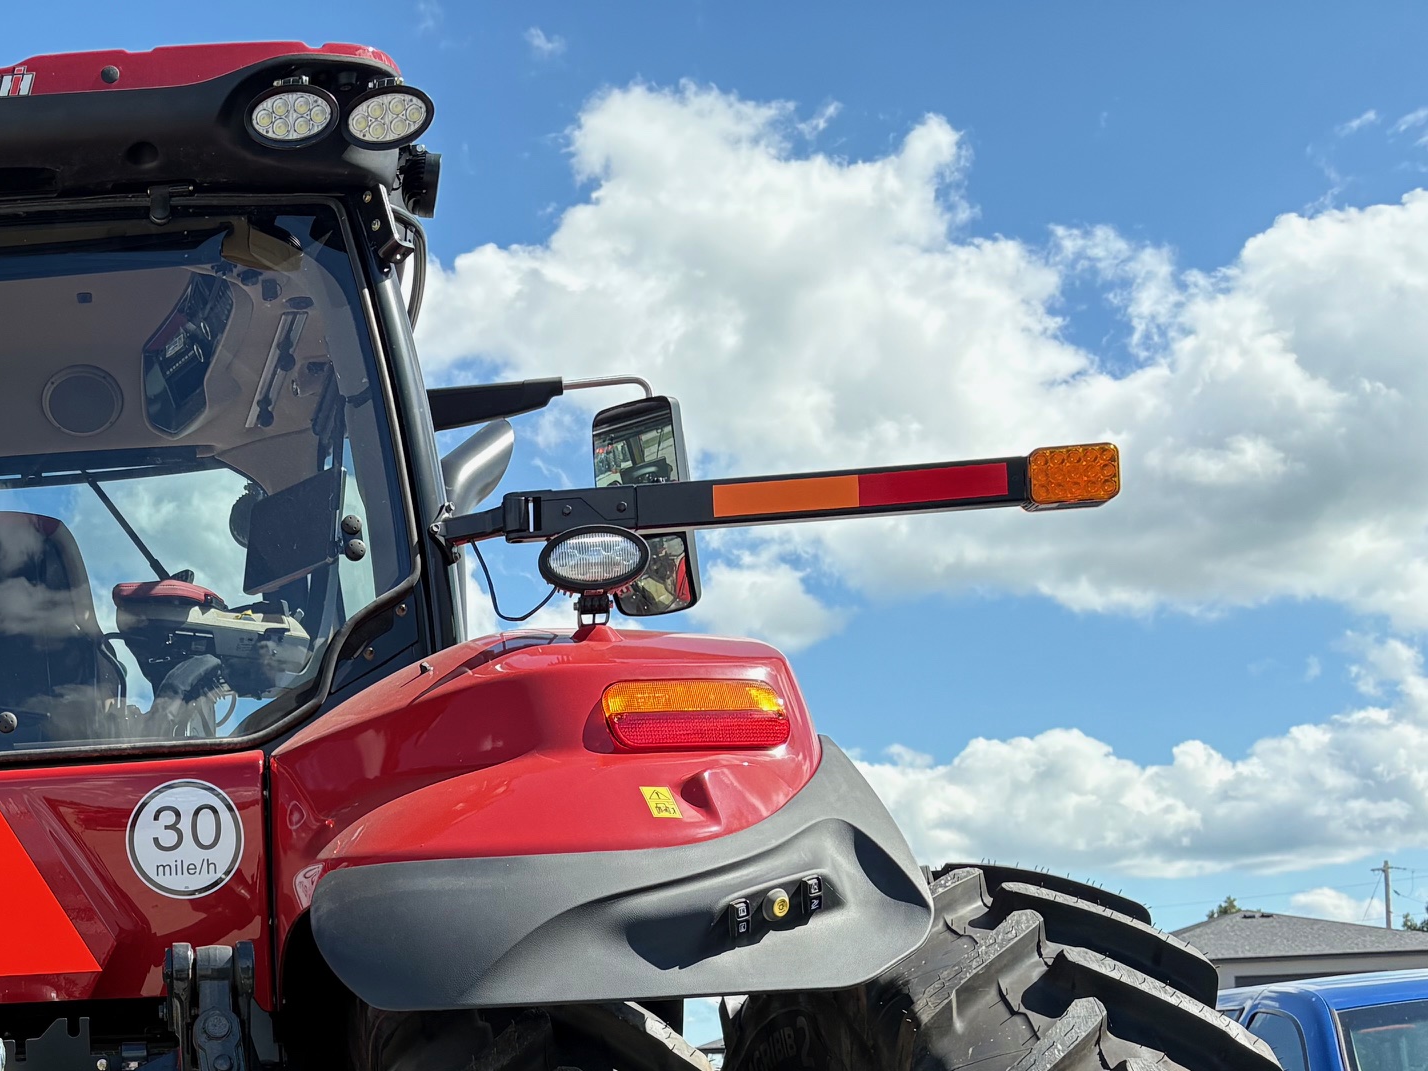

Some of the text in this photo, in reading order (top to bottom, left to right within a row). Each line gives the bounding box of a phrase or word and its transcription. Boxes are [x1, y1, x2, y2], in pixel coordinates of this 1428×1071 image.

[152, 804, 222, 852] 30
[156, 858, 218, 877] mile/h
[797, 1016, 815, 1067] 2
